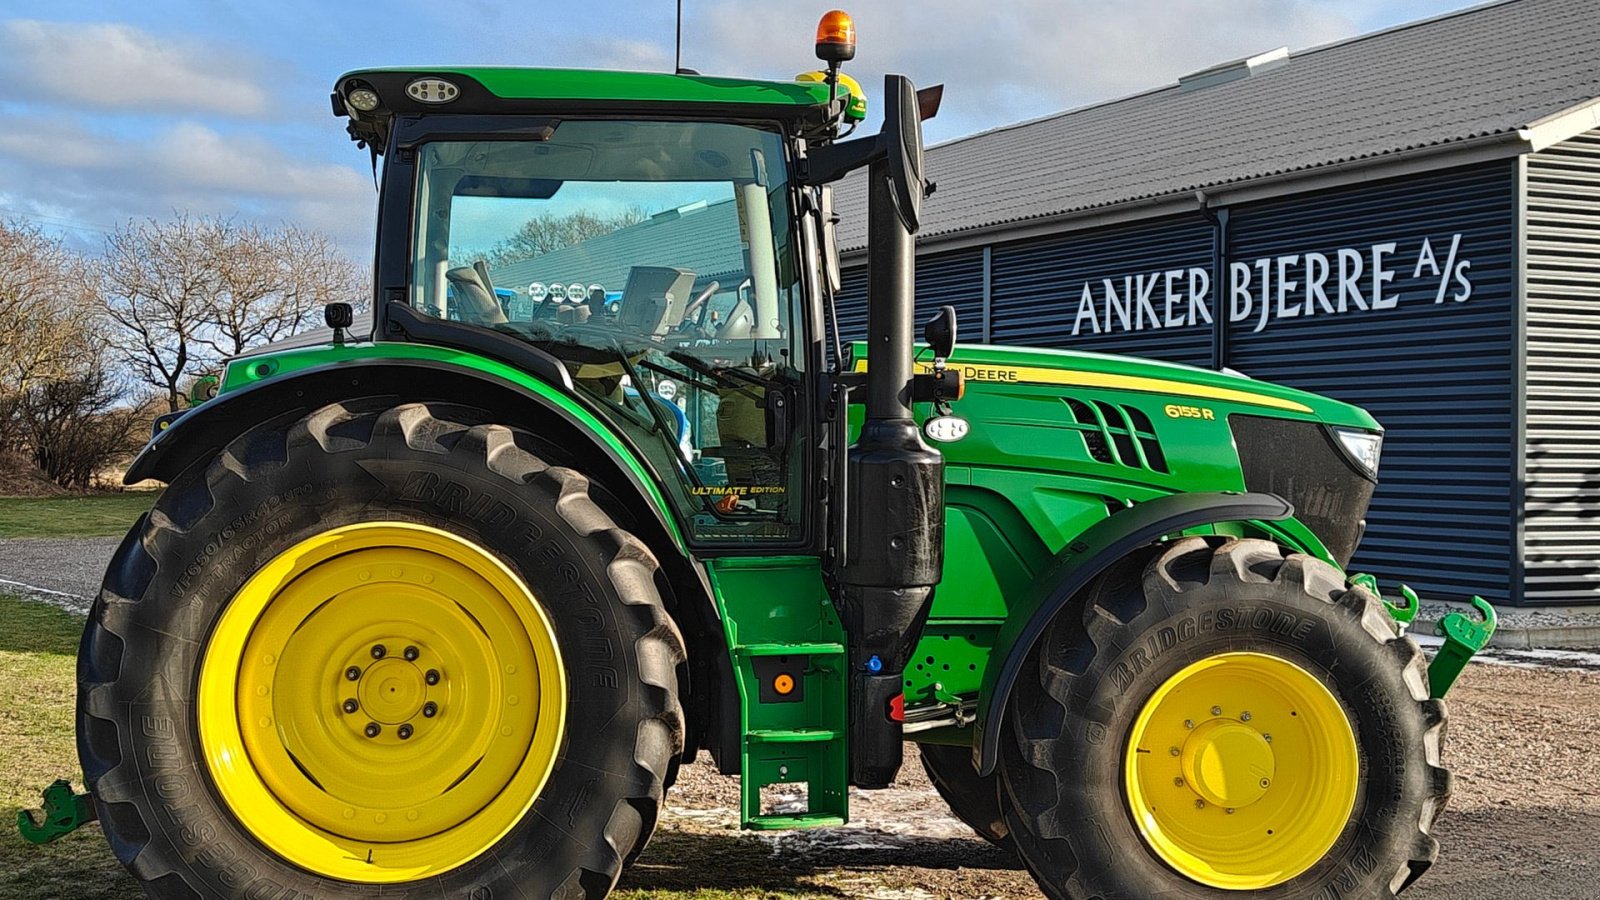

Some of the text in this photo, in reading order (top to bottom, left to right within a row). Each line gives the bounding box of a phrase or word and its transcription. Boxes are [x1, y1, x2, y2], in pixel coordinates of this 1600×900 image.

[1071, 234, 1472, 335] ANKER BJERRE A/S
[964, 367, 1018, 381] DEERE
[692, 486, 786, 496] ULTIMATE EDITION
[1109, 606, 1316, 696] BRIDGESTONE
